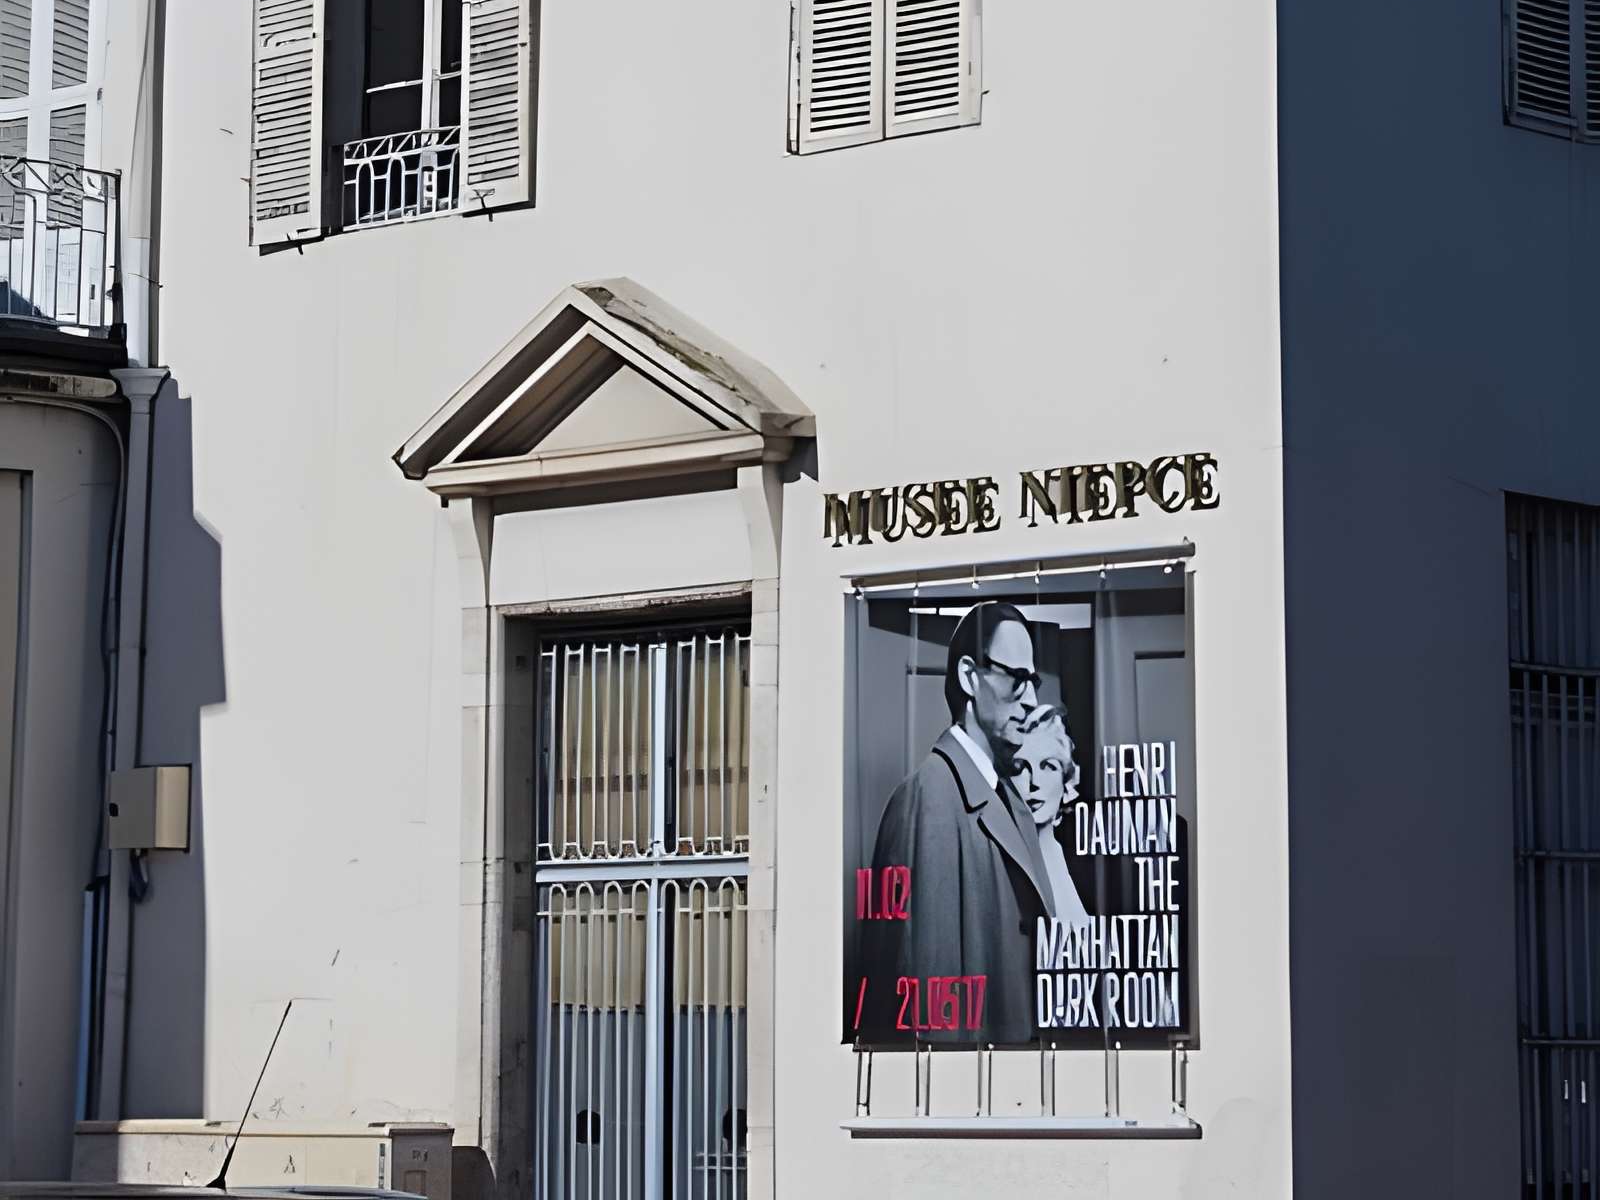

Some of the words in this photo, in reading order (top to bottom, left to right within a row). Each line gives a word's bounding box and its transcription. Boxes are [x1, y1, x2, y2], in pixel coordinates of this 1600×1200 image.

[1103, 740, 1177, 798] HENRI
[1074, 798, 1177, 856] DAUMAN
[1134, 856, 1180, 912] THE
[1036, 914, 1180, 971] MANHATTAN
